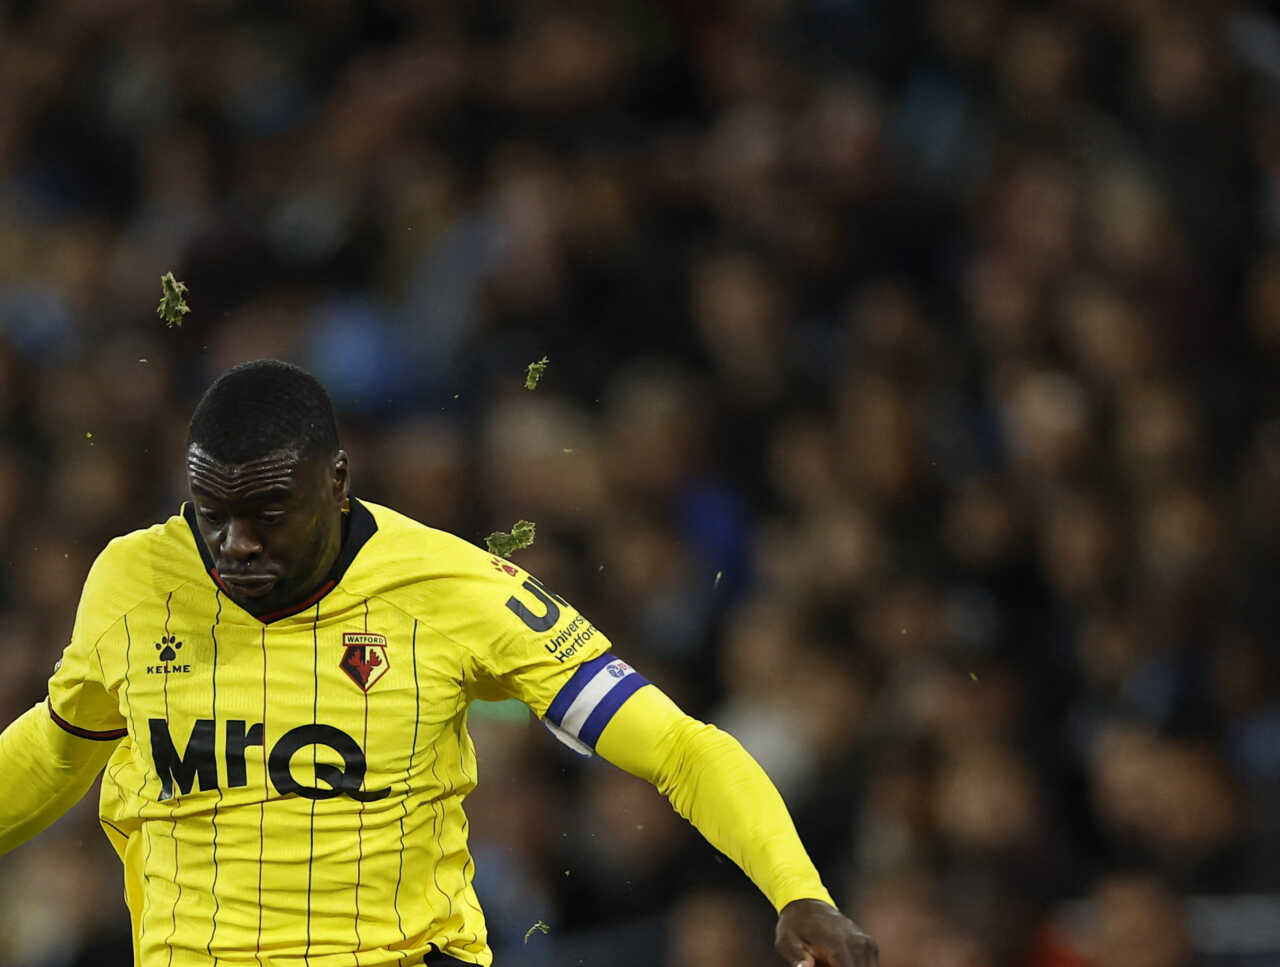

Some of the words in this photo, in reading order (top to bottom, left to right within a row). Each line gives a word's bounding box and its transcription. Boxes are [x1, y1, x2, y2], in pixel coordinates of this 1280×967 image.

[347, 635, 384, 643] WATFORD
[147, 664, 191, 675] KELME
[148, 718, 392, 803] MrQ
